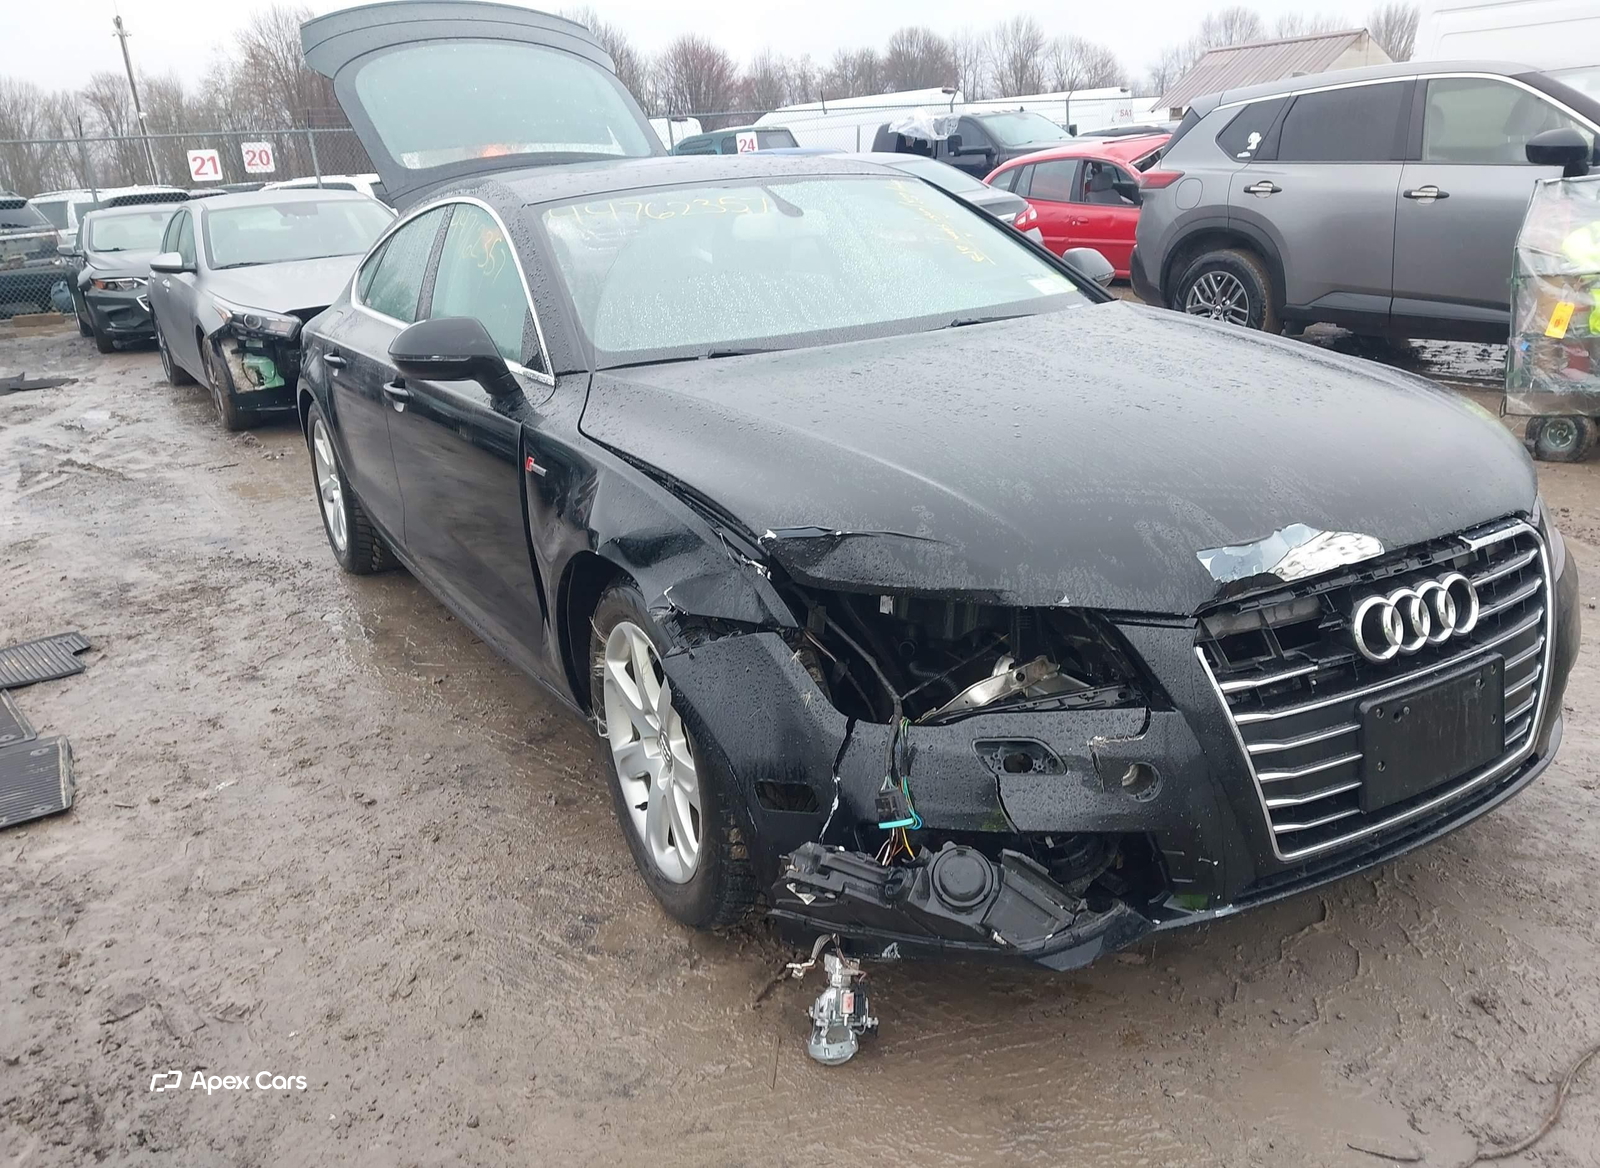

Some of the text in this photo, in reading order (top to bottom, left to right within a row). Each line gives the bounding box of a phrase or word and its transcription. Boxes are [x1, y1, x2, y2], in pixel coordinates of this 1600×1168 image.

[739, 138, 756, 153] 24
[192, 155, 219, 176] 21
[245, 149, 271, 167] 20
